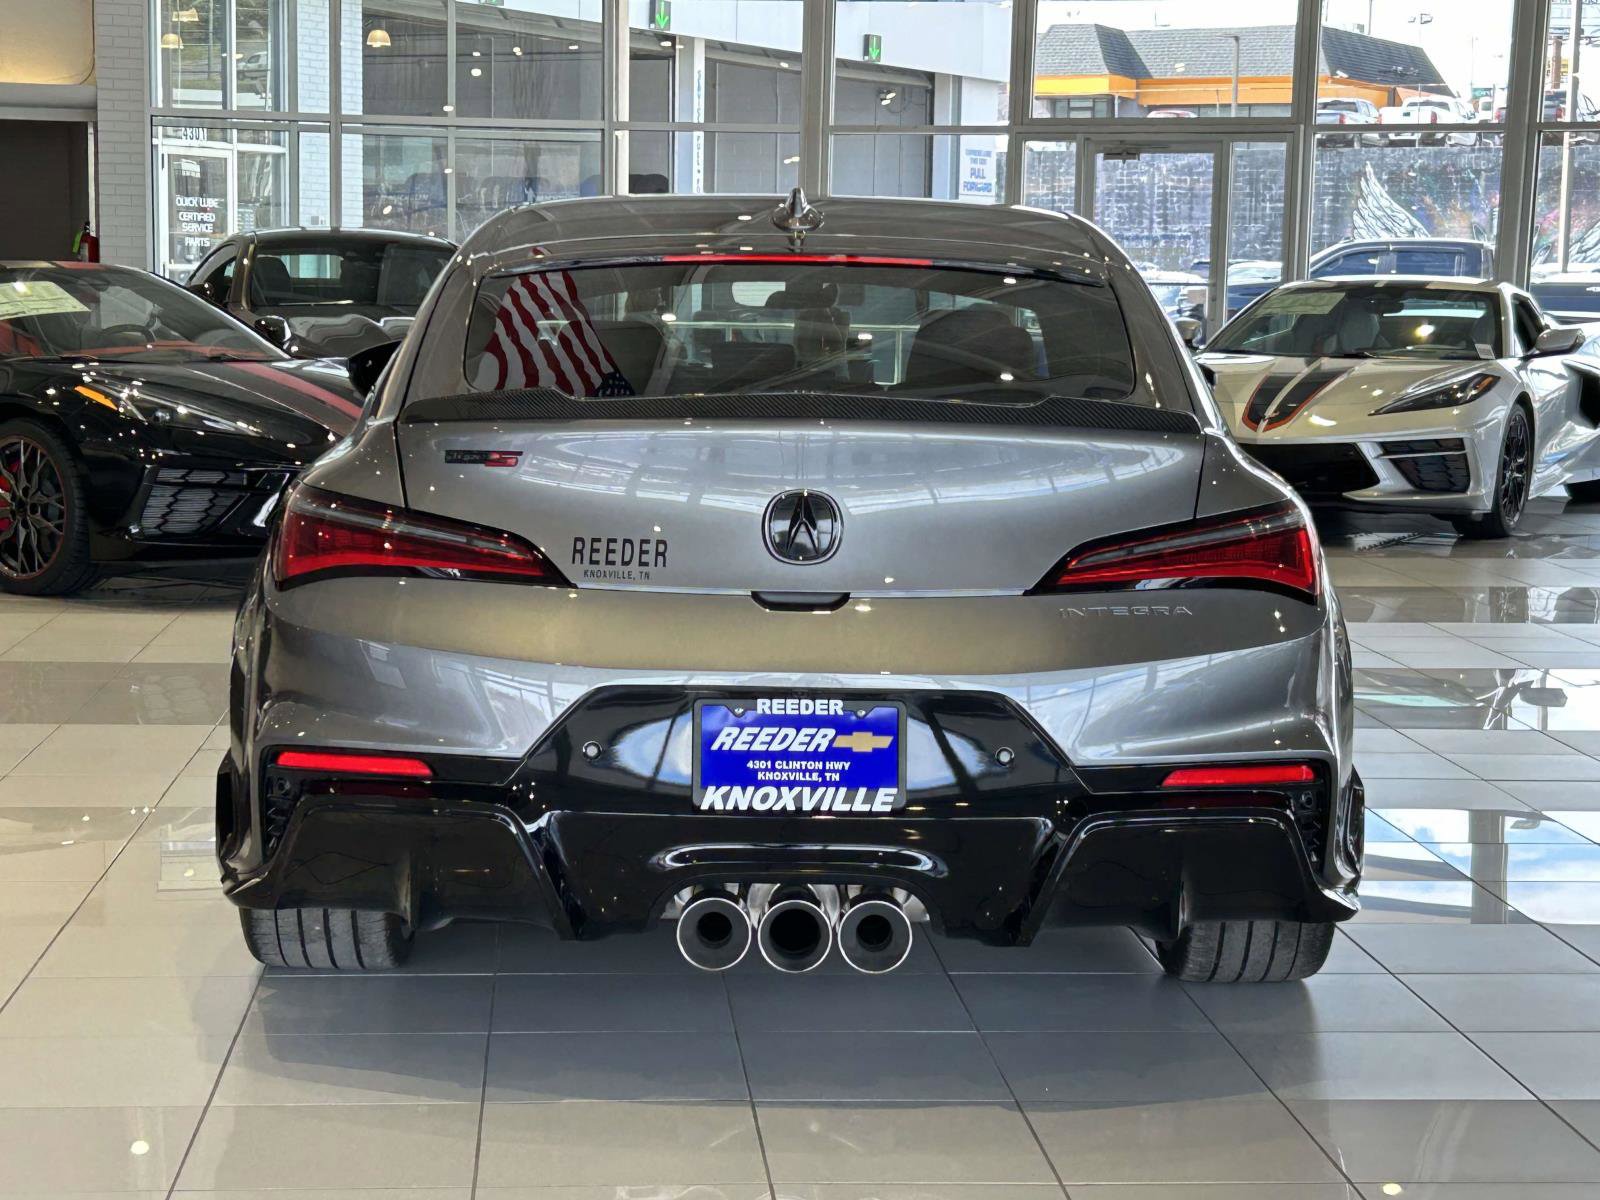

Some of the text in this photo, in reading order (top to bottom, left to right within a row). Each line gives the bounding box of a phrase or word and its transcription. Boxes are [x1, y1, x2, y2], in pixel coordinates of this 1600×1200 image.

[175, 196, 220, 208] QUICK LUBE
[178, 211, 216, 222] CERTIFIED
[181, 222, 214, 233] SERVICE
[184, 236, 211, 247] PARTS
[571, 536, 668, 568] REEDER
[583, 569, 651, 581] KNOXVILLE, TN
[1059, 605, 1193, 617] INTEGRA
[756, 698, 844, 716] REEDER
[710, 726, 836, 752] REEDER
[746, 760, 851, 771] 4301 CLINTON HWY
[757, 771, 840, 782] KNOXVILLE, TN
[700, 785, 898, 812] KNOXVILLE
